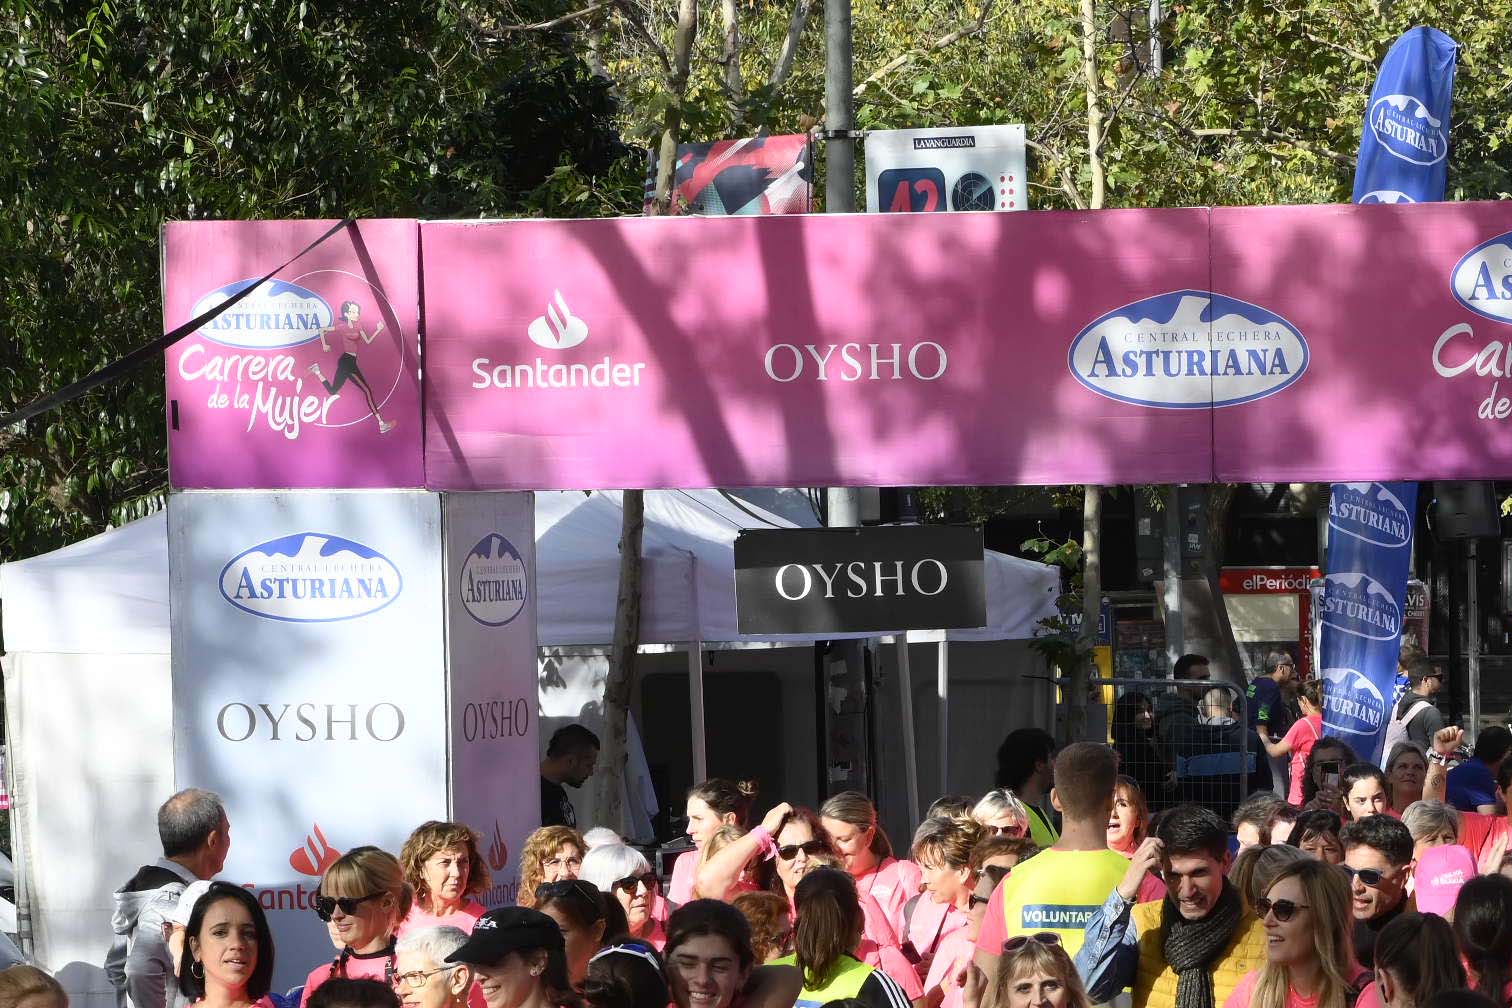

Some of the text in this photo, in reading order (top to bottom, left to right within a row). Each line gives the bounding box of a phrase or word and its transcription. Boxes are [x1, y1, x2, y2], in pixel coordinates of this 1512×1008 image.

[1124, 330, 1282, 343] CENTRAL LECHERA
[178, 344, 296, 382] Carrera
[472, 357, 646, 389] Santander
[764, 341, 948, 382] OYSHO
[1087, 335, 1291, 378] ASTURIANA
[208, 384, 250, 409] de la
[246, 378, 341, 440] Mujer
[1478, 382, 1512, 420] de
[1329, 493, 1406, 540] ASTURIANA
[233, 567, 390, 600] ASTURIANA
[466, 567, 524, 603] ASTURIANA
[775, 558, 948, 601] OYSHO
[217, 702, 406, 742] OYSHO
[463, 697, 529, 742] OYSHO
